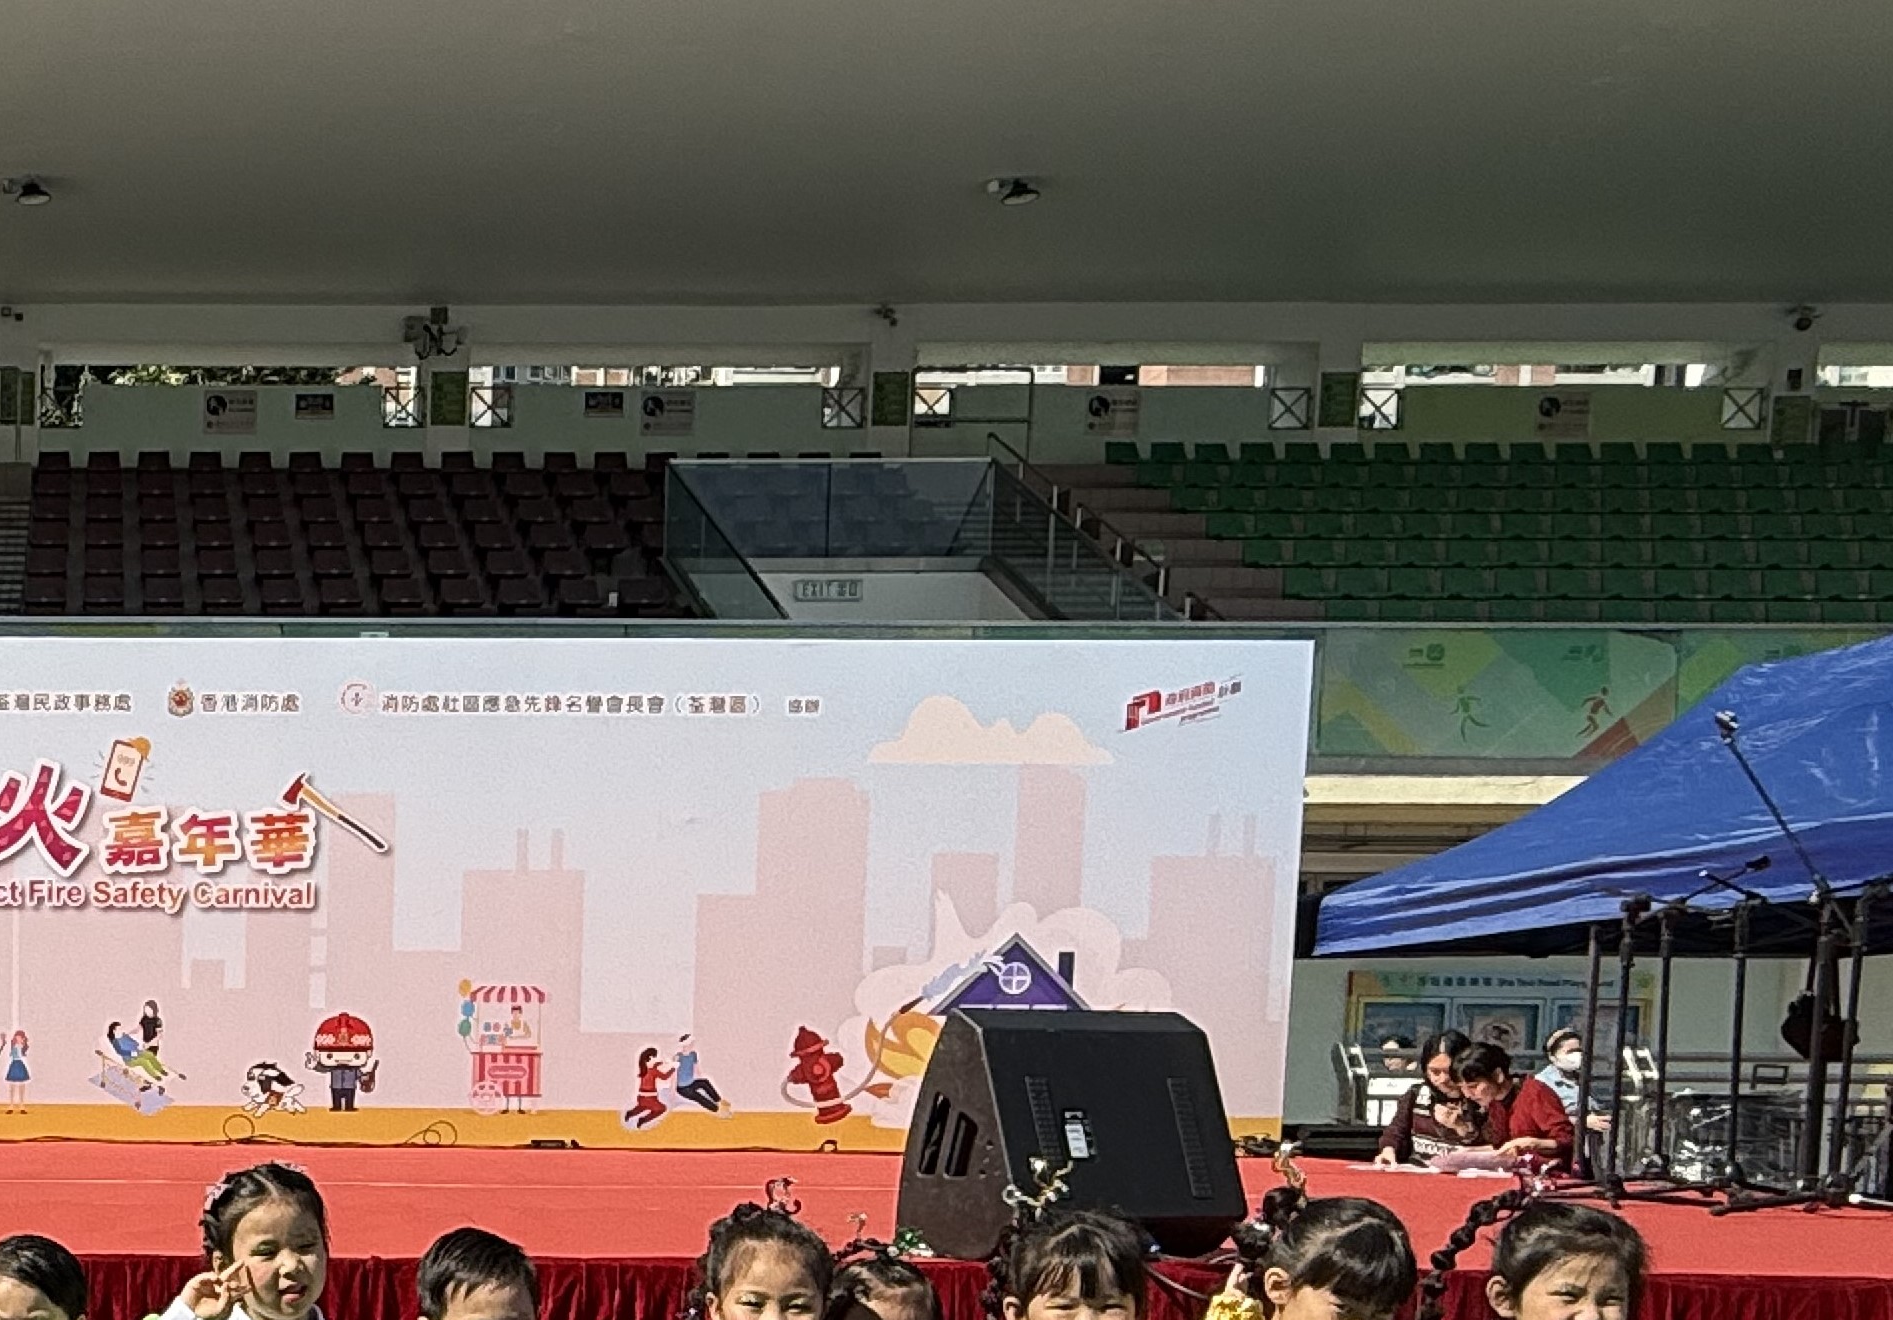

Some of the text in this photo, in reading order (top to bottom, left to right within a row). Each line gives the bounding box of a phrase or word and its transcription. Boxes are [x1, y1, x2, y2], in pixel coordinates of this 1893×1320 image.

[803, 582, 831, 596] EXIT
[200, 693, 301, 712] 香港消防處
[107, 811, 311, 867] 嘉年華
[29, 881, 82, 904] Fire
[93, 881, 183, 912] Safety
[193, 881, 313, 905] Carnival
